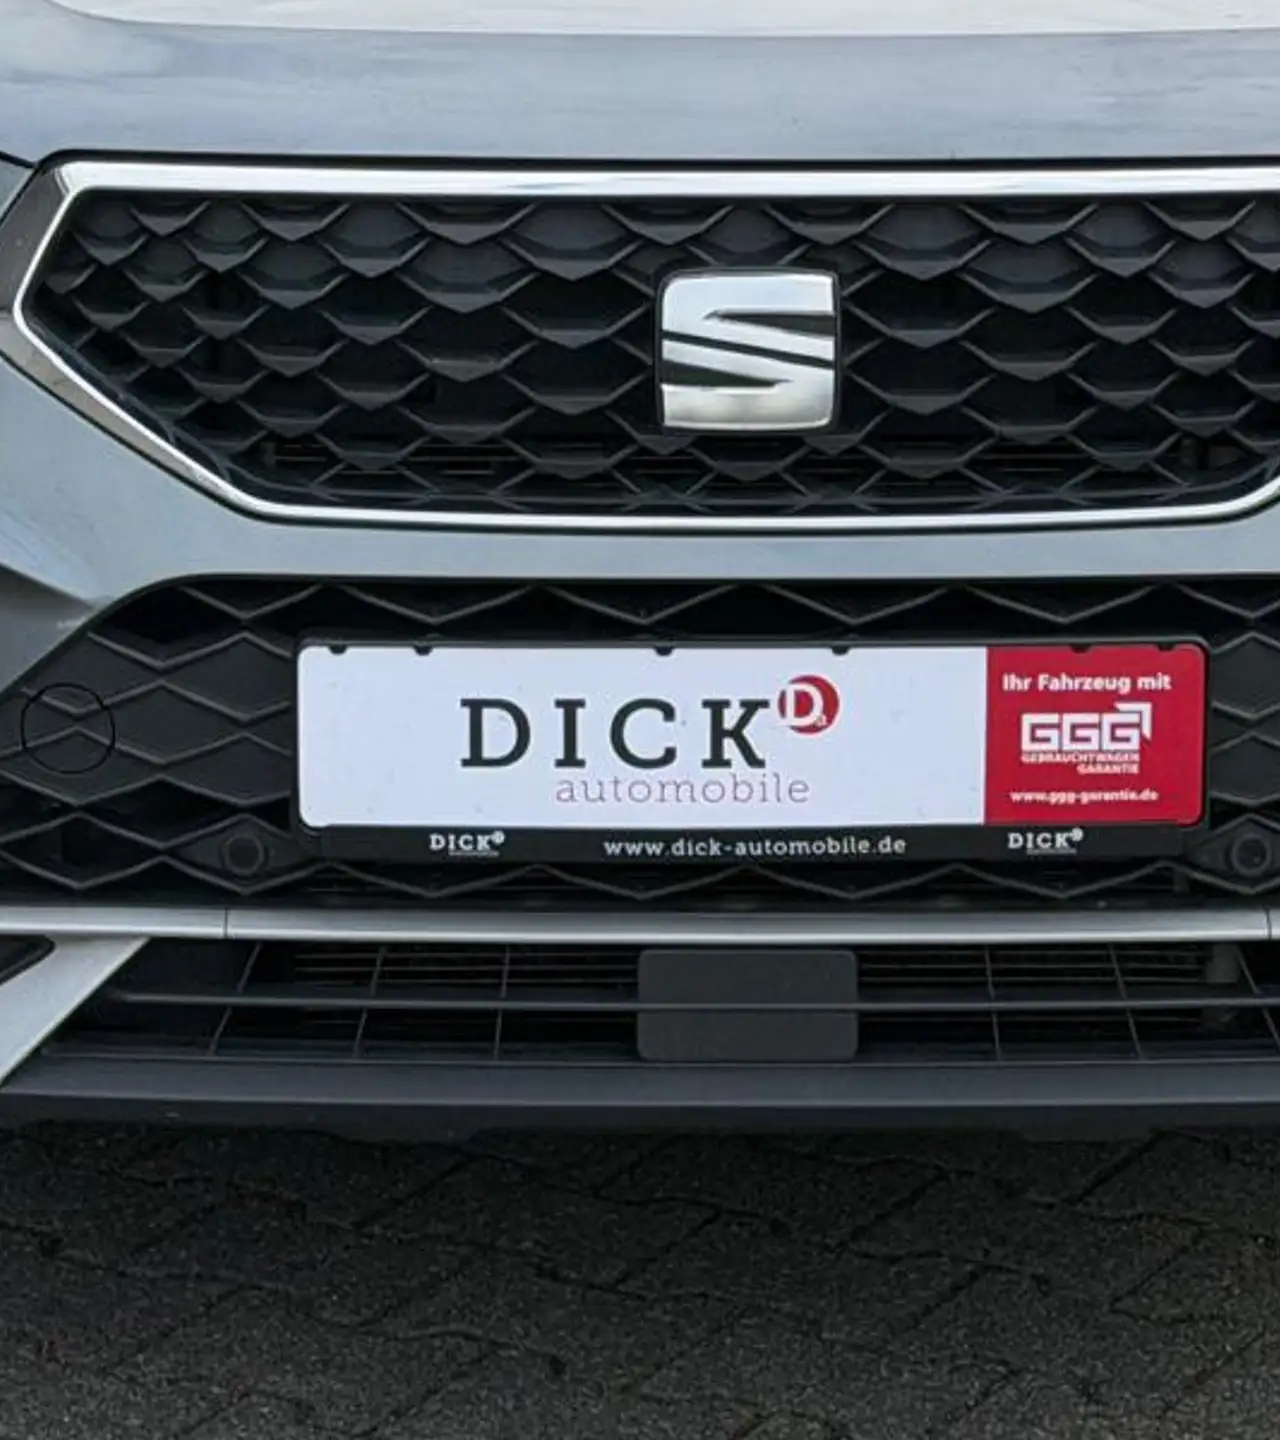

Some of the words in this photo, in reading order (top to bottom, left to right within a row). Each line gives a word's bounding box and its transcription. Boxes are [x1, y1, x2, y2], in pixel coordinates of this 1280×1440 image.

[1002, 673, 1032, 691] Ihr
[1038, 672, 1132, 694] Fahrzeug
[1137, 672, 1172, 691] mit
[460, 697, 770, 769] DICK
[1021, 712, 1141, 751] GGG
[556, 772, 810, 803] automobile
[1009, 788, 1159, 804] www.ggg-garantie.de
[429, 833, 491, 851] DICK
[603, 835, 907, 856] www.dick-automobile.de
[1007, 831, 1071, 850] DICK
